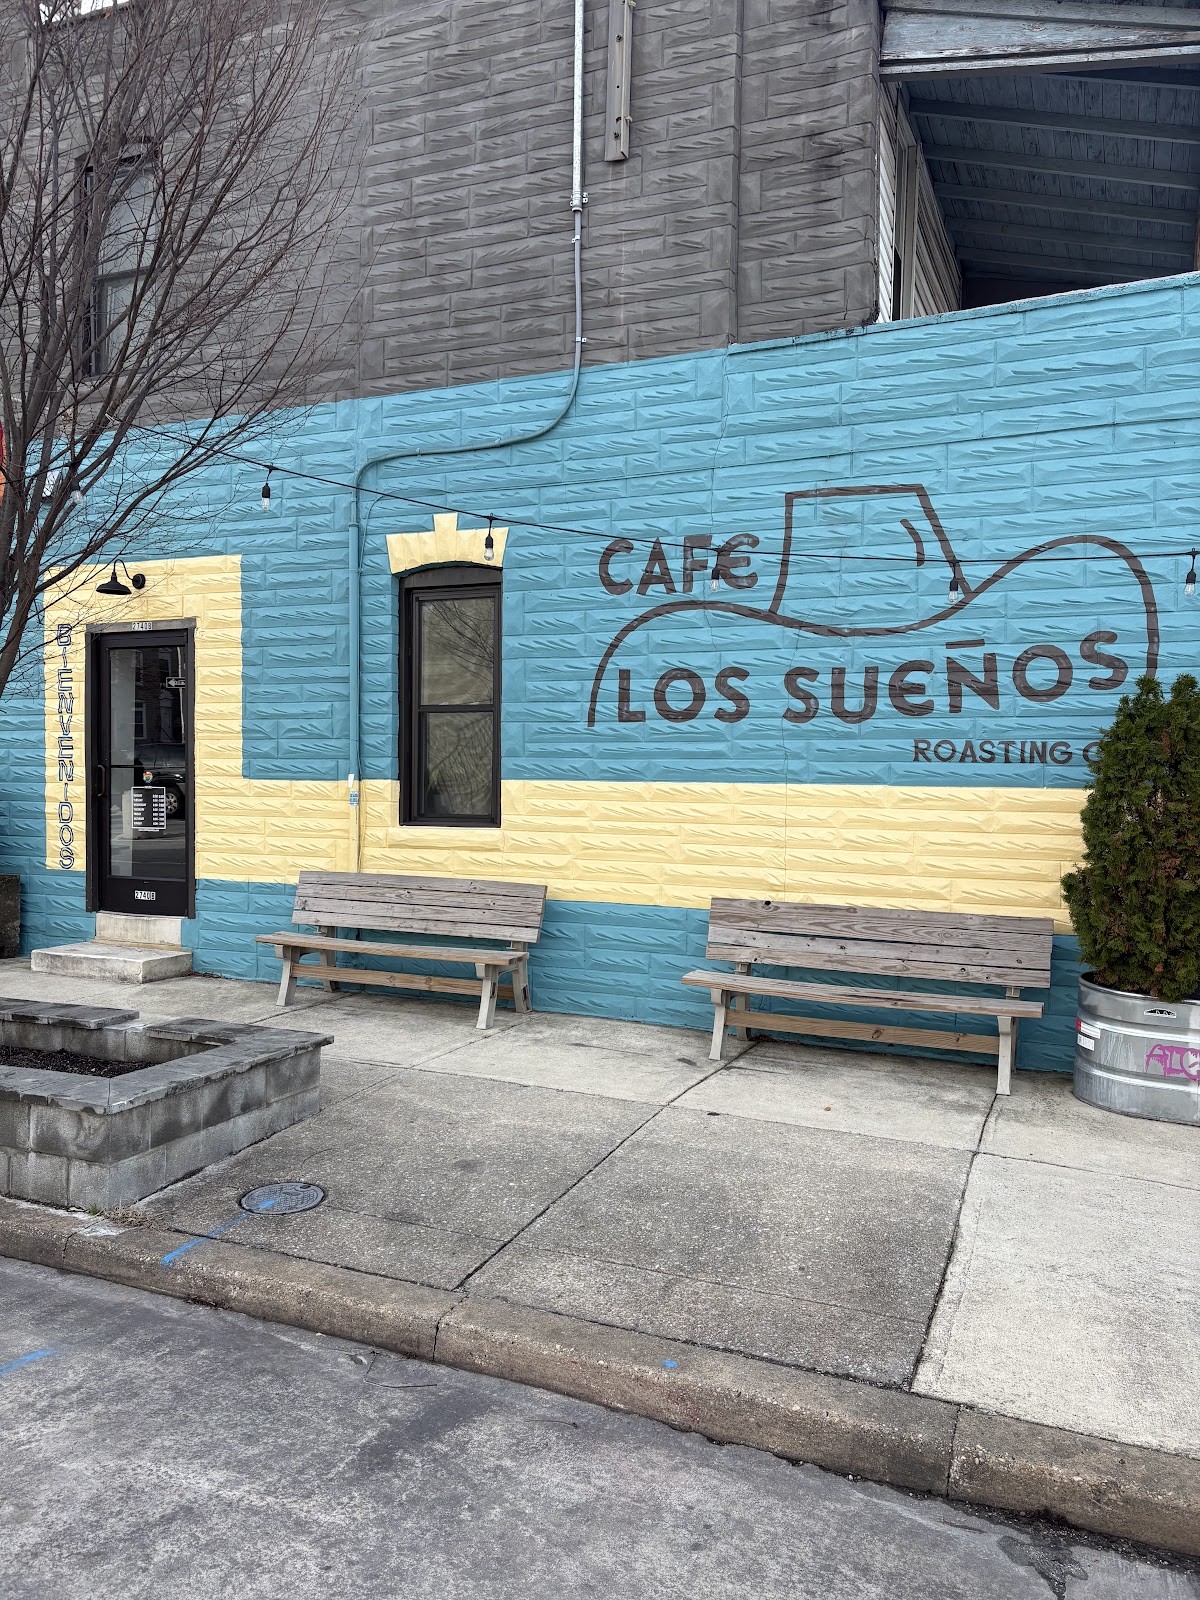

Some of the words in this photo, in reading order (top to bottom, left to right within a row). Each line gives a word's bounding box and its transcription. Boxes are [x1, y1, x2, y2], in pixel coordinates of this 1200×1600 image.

[599, 533, 760, 595] CAFE
[618, 667, 751, 723] LOS
[782, 630, 1129, 724] SUEÑOS
[57, 623, 75, 870] BIENVENIDOS
[912, 739, 1073, 764] ROASTING
[1082, 741, 1104, 765] C
